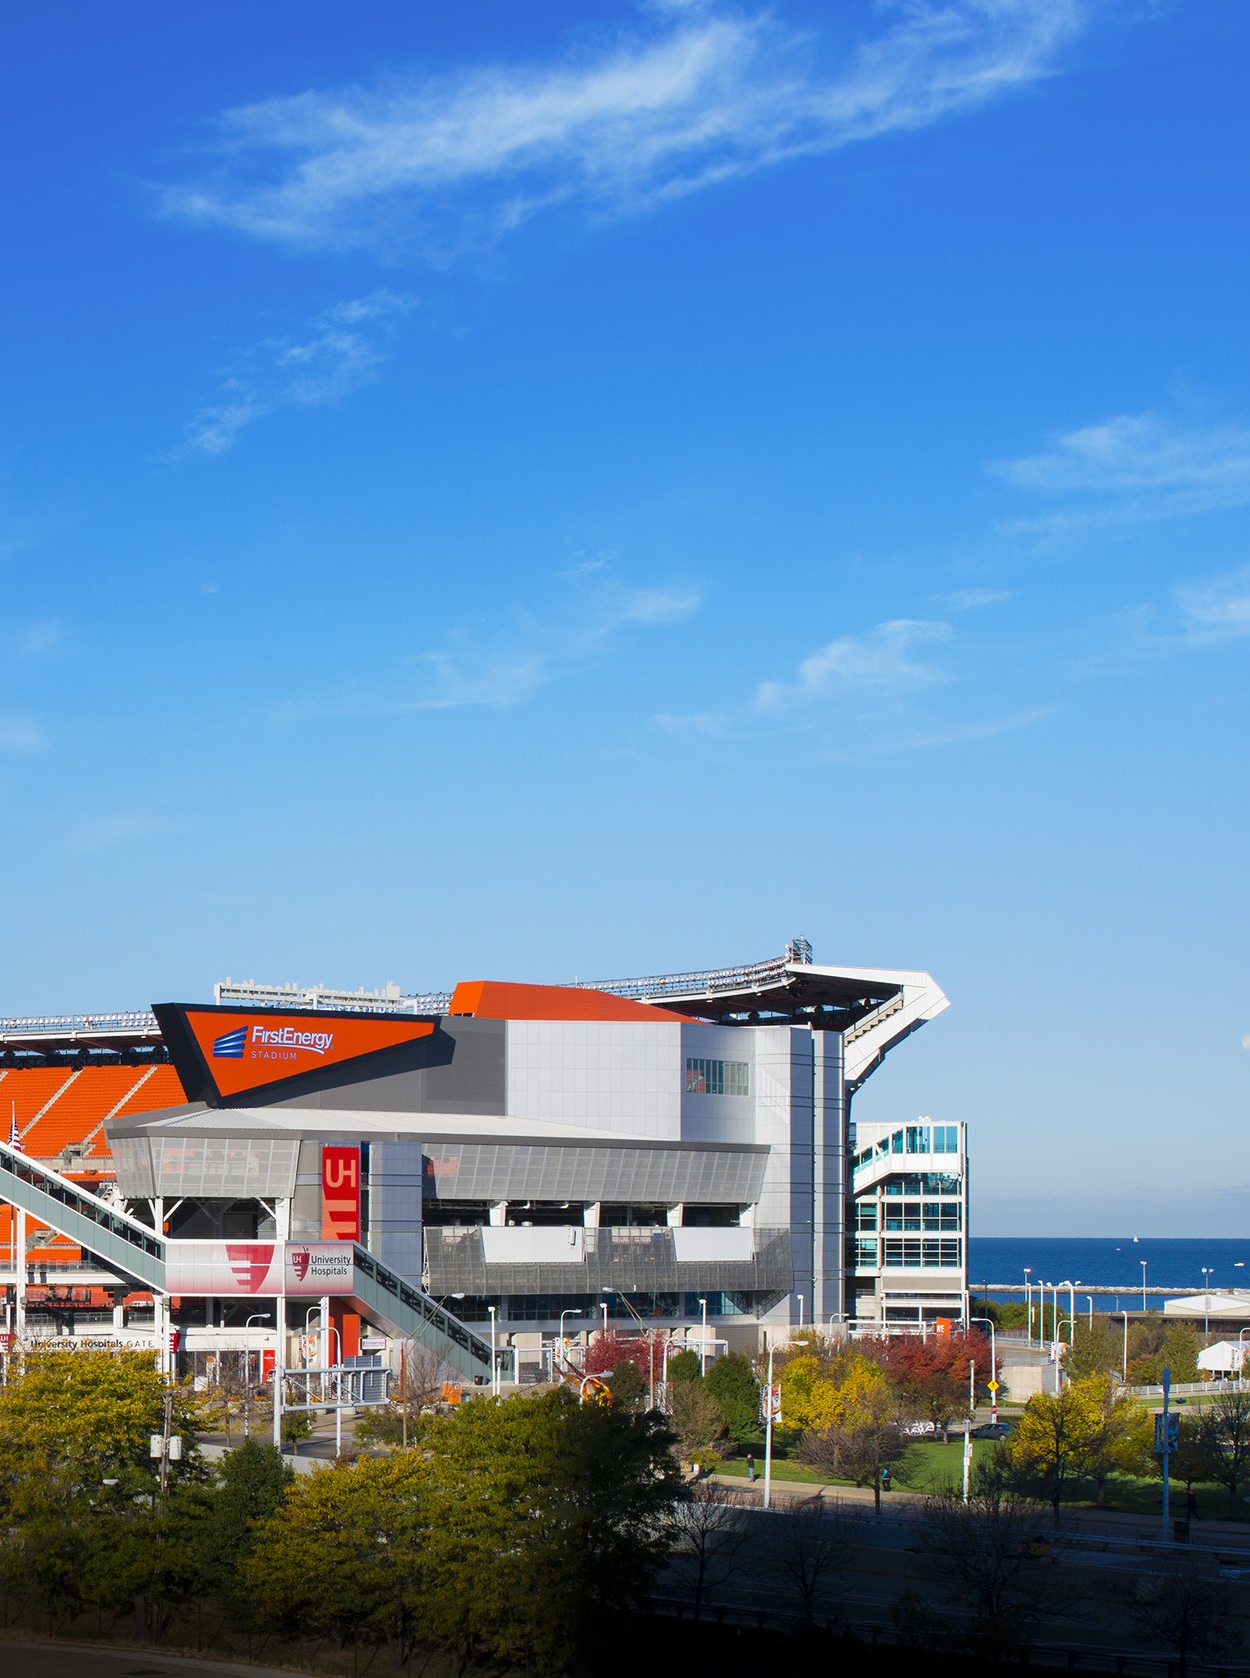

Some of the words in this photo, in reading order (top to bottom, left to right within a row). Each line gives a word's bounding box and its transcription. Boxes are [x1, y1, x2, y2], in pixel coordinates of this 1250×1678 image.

[252, 1026, 334, 1049] FirstEnergy
[251, 1051, 297, 1060] STADIUM
[325, 1159, 356, 1188] UH
[311, 1255, 351, 1266] University
[311, 1267, 347, 1277] Hospitals
[31, 1339, 78, 1350] University
[80, 1339, 123, 1349] Hospitals
[126, 1340, 153, 1348] GATE
